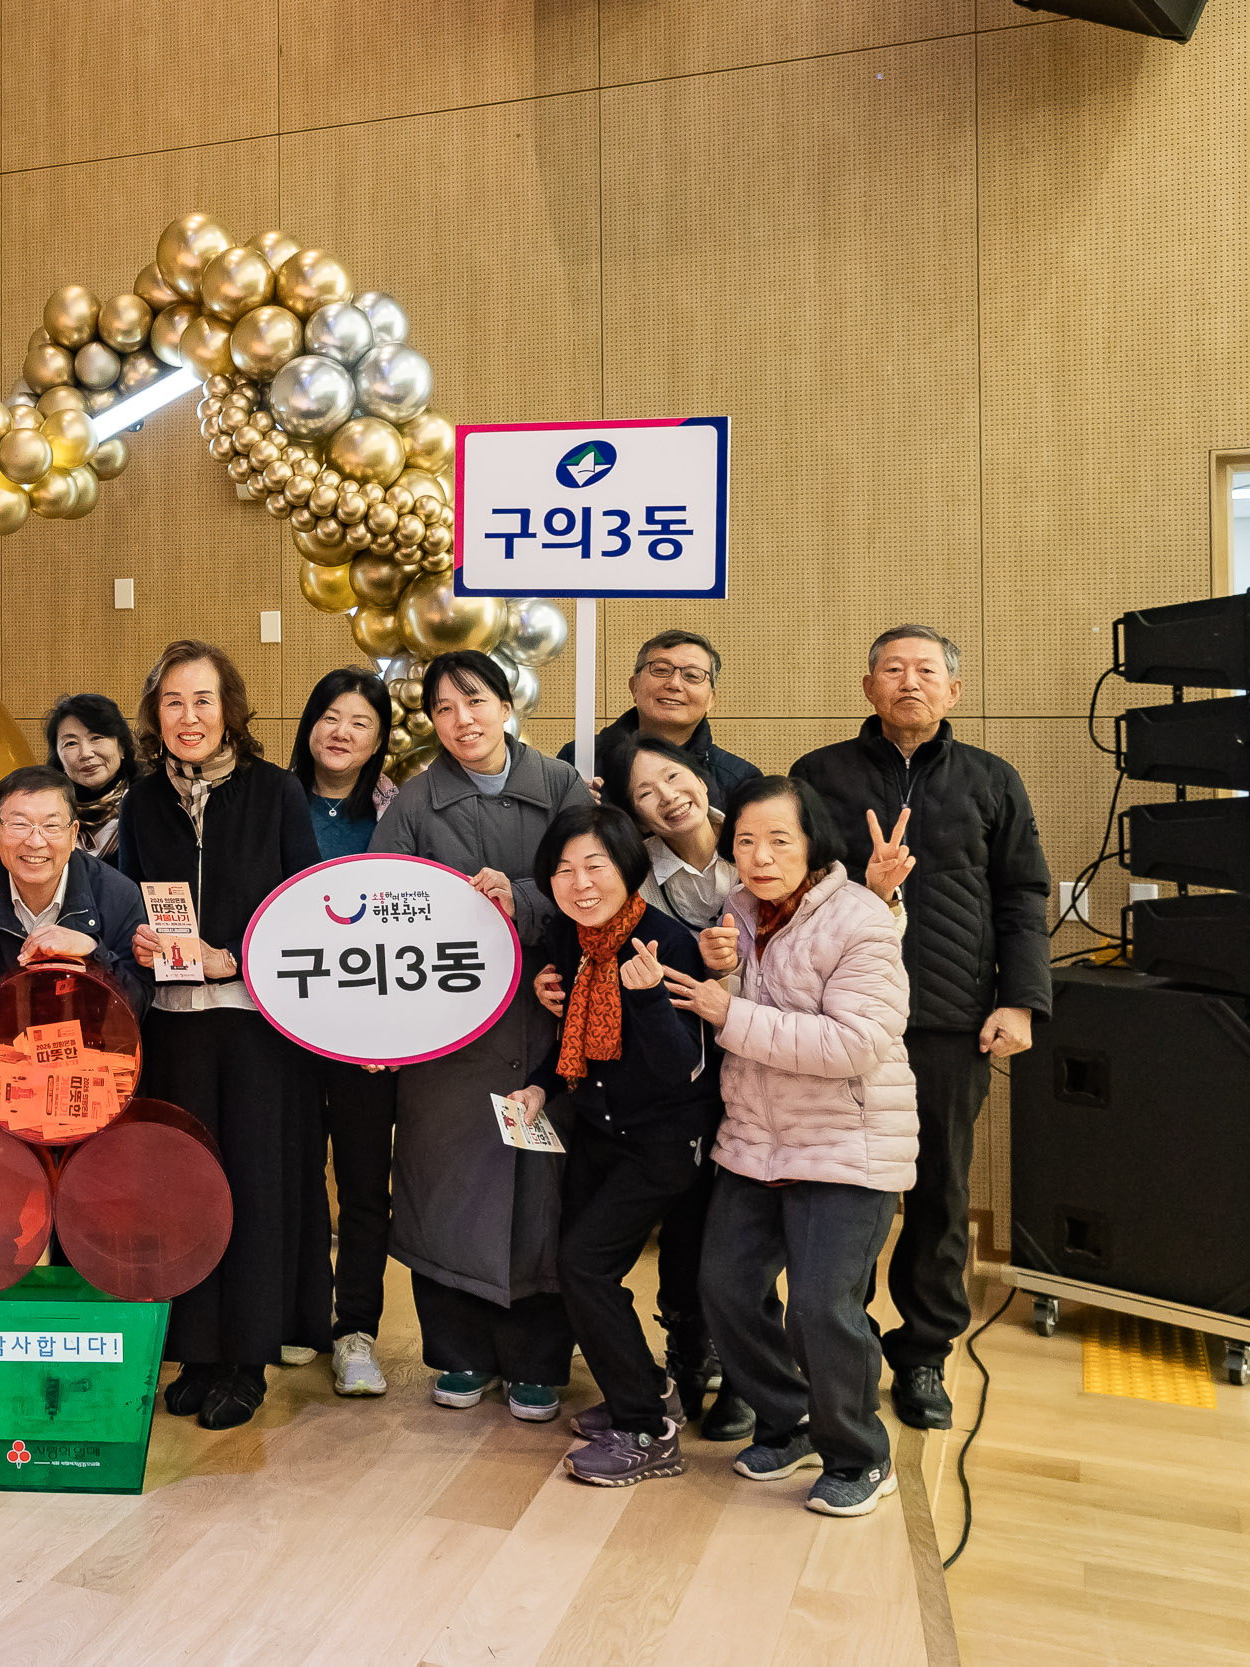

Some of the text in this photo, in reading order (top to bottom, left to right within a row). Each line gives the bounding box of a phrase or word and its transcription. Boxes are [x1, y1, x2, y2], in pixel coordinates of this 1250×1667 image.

[484, 505, 694, 561] 구의3동
[372, 890, 430, 904] 소통하며 발전하는
[151, 904, 188, 914] 따뜻한
[372, 902, 431, 923] 행복광진
[277, 941, 485, 999] 구의3동
[37, 1047, 78, 1063] 따뜻한
[69, 1076, 82, 1118] 따뜻한
